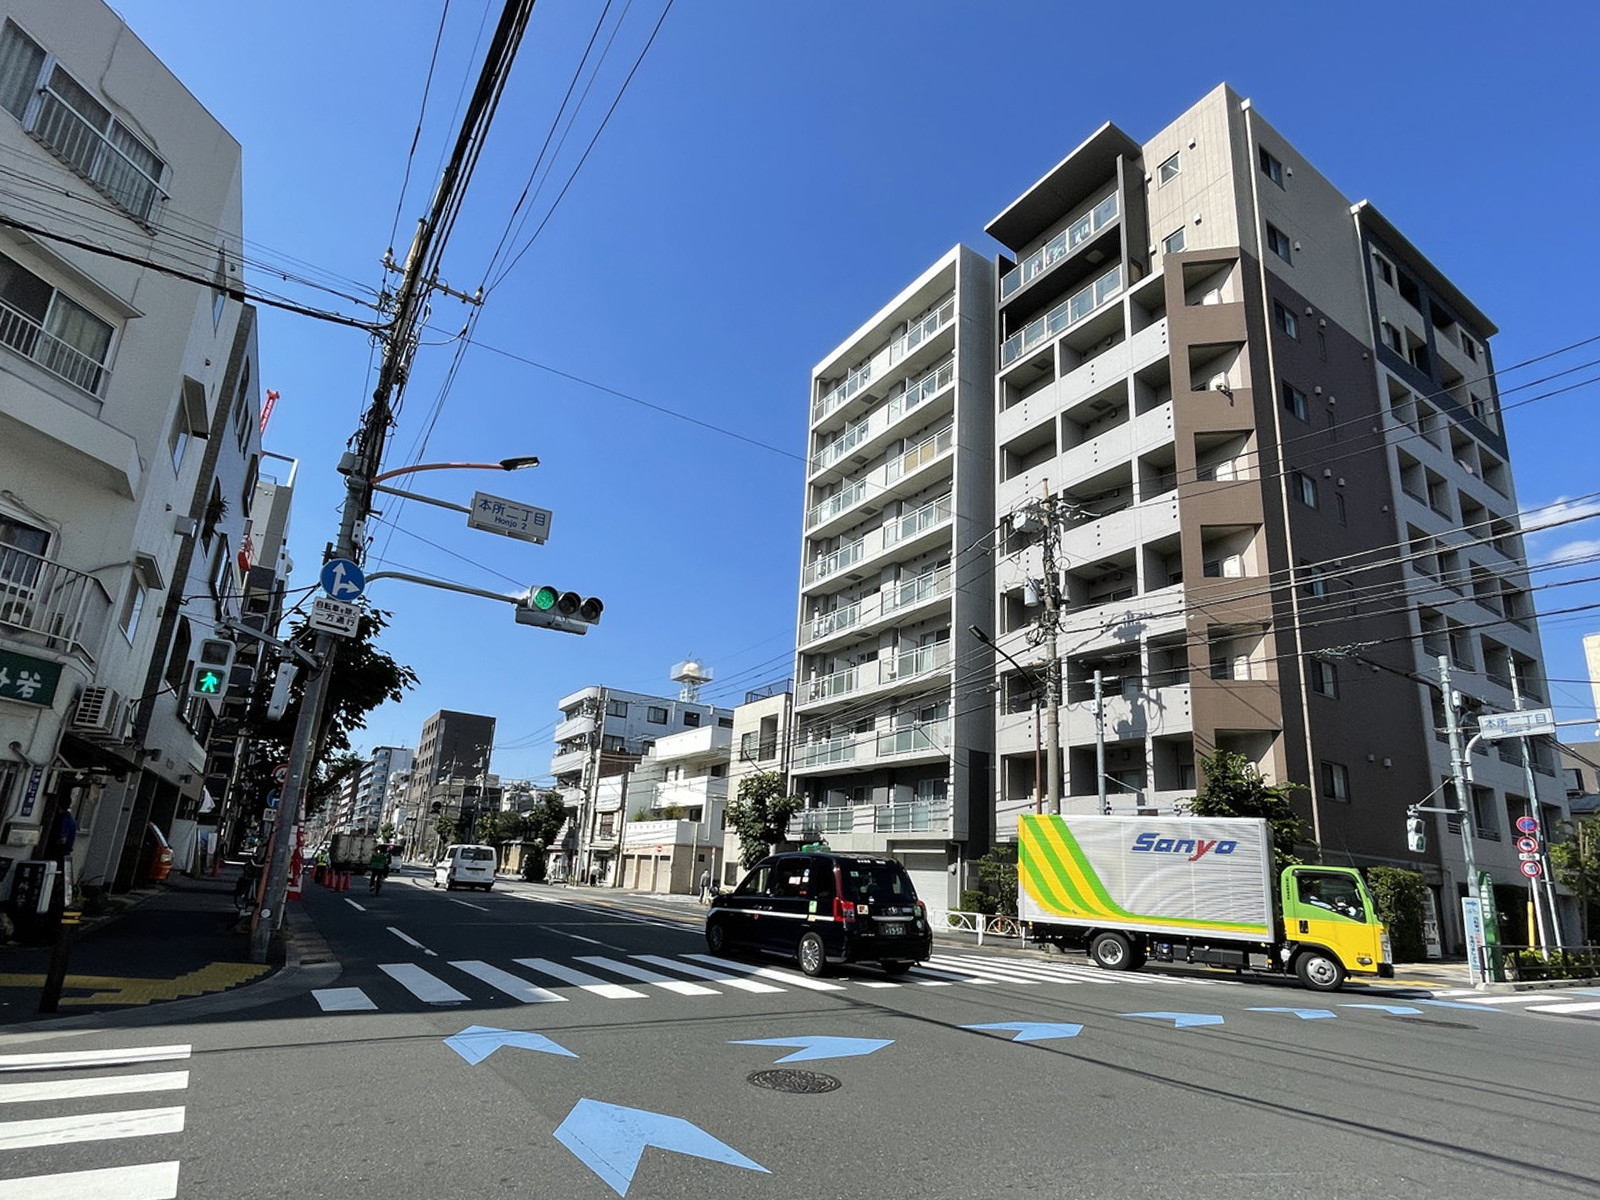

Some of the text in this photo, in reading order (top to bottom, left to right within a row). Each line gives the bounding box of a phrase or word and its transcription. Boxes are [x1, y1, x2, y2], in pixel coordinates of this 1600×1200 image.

[479, 498, 546, 527] 本所二丁目
[494, 516, 518, 528] Honjo
[315, 612, 355, 627] 一方通行
[1485, 713, 1547, 729] 本所二丁目
[1132, 832, 1239, 862] Sanyo
